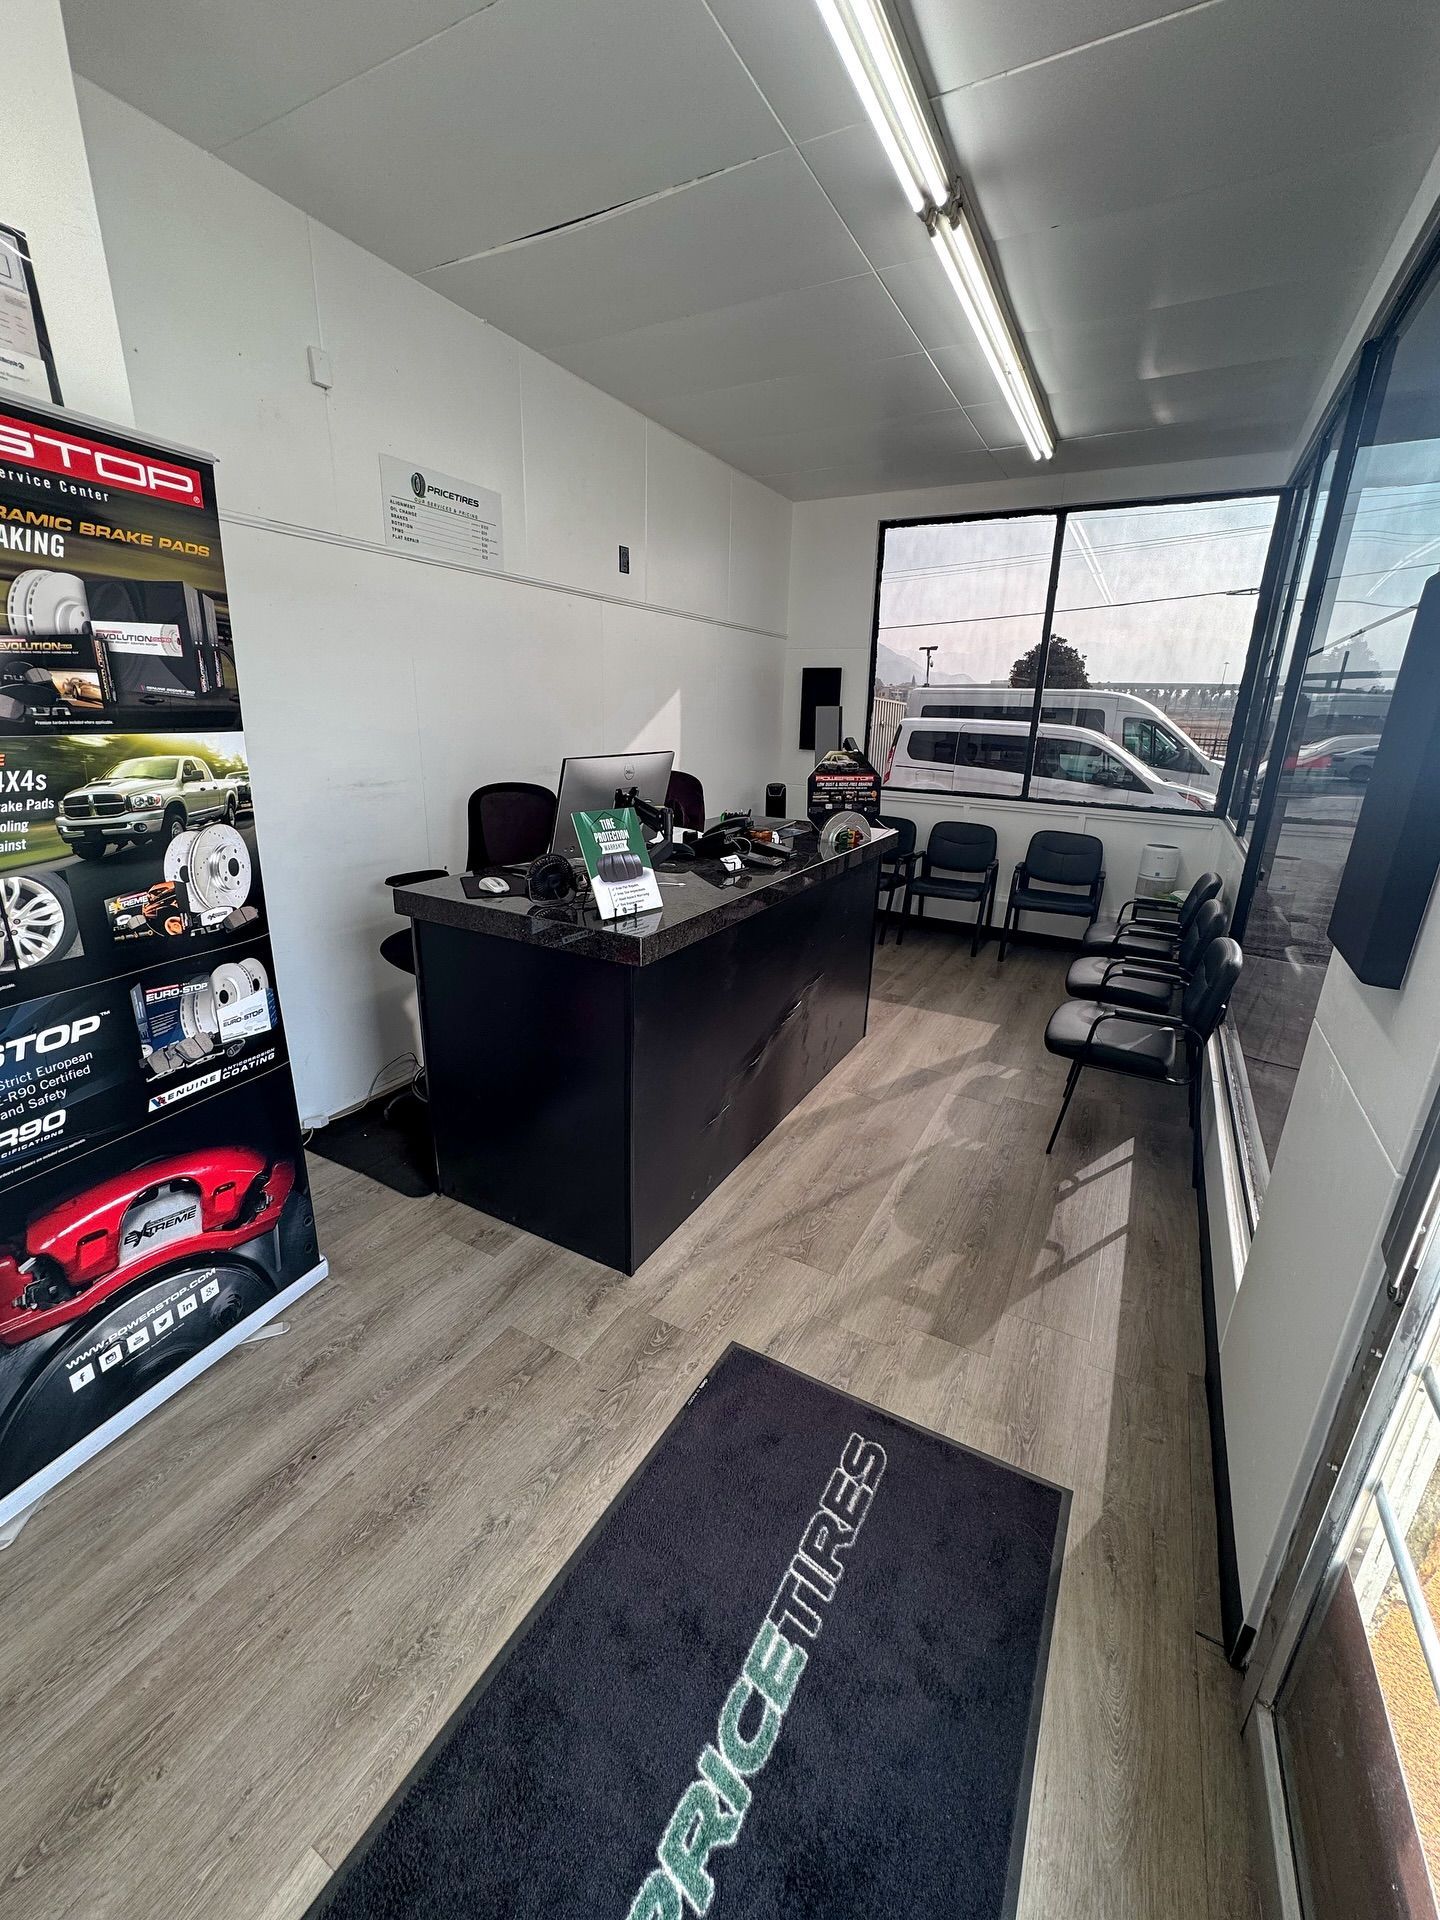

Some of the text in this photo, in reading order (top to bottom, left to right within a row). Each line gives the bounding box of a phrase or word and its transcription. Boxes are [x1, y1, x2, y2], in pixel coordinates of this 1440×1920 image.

[59, 480, 110, 502] Center
[427, 485, 480, 508] PRICETIRES
[79, 521, 154, 547] BRAKE
[159, 537, 211, 558] PADS
[26, 797, 55, 811] Pads
[593, 829, 630, 843] PROTECTION
[599, 817, 616, 830] TIRE
[145, 982, 208, 1003] EURO-STOP
[0, 1015, 101, 1068] TOP
[36, 1051, 94, 1078] European
[222, 1048, 276, 1073] ANTICORROSION
[222, 1053, 276, 1080] COATING
[40, 1065, 91, 1090] Certified
[0, 1088, 67, 1121] and Safety
[1, 1129, 64, 1159] CIFICATIONS
[65, 1267, 217, 1370] WWW.POWERSTOP.COM
